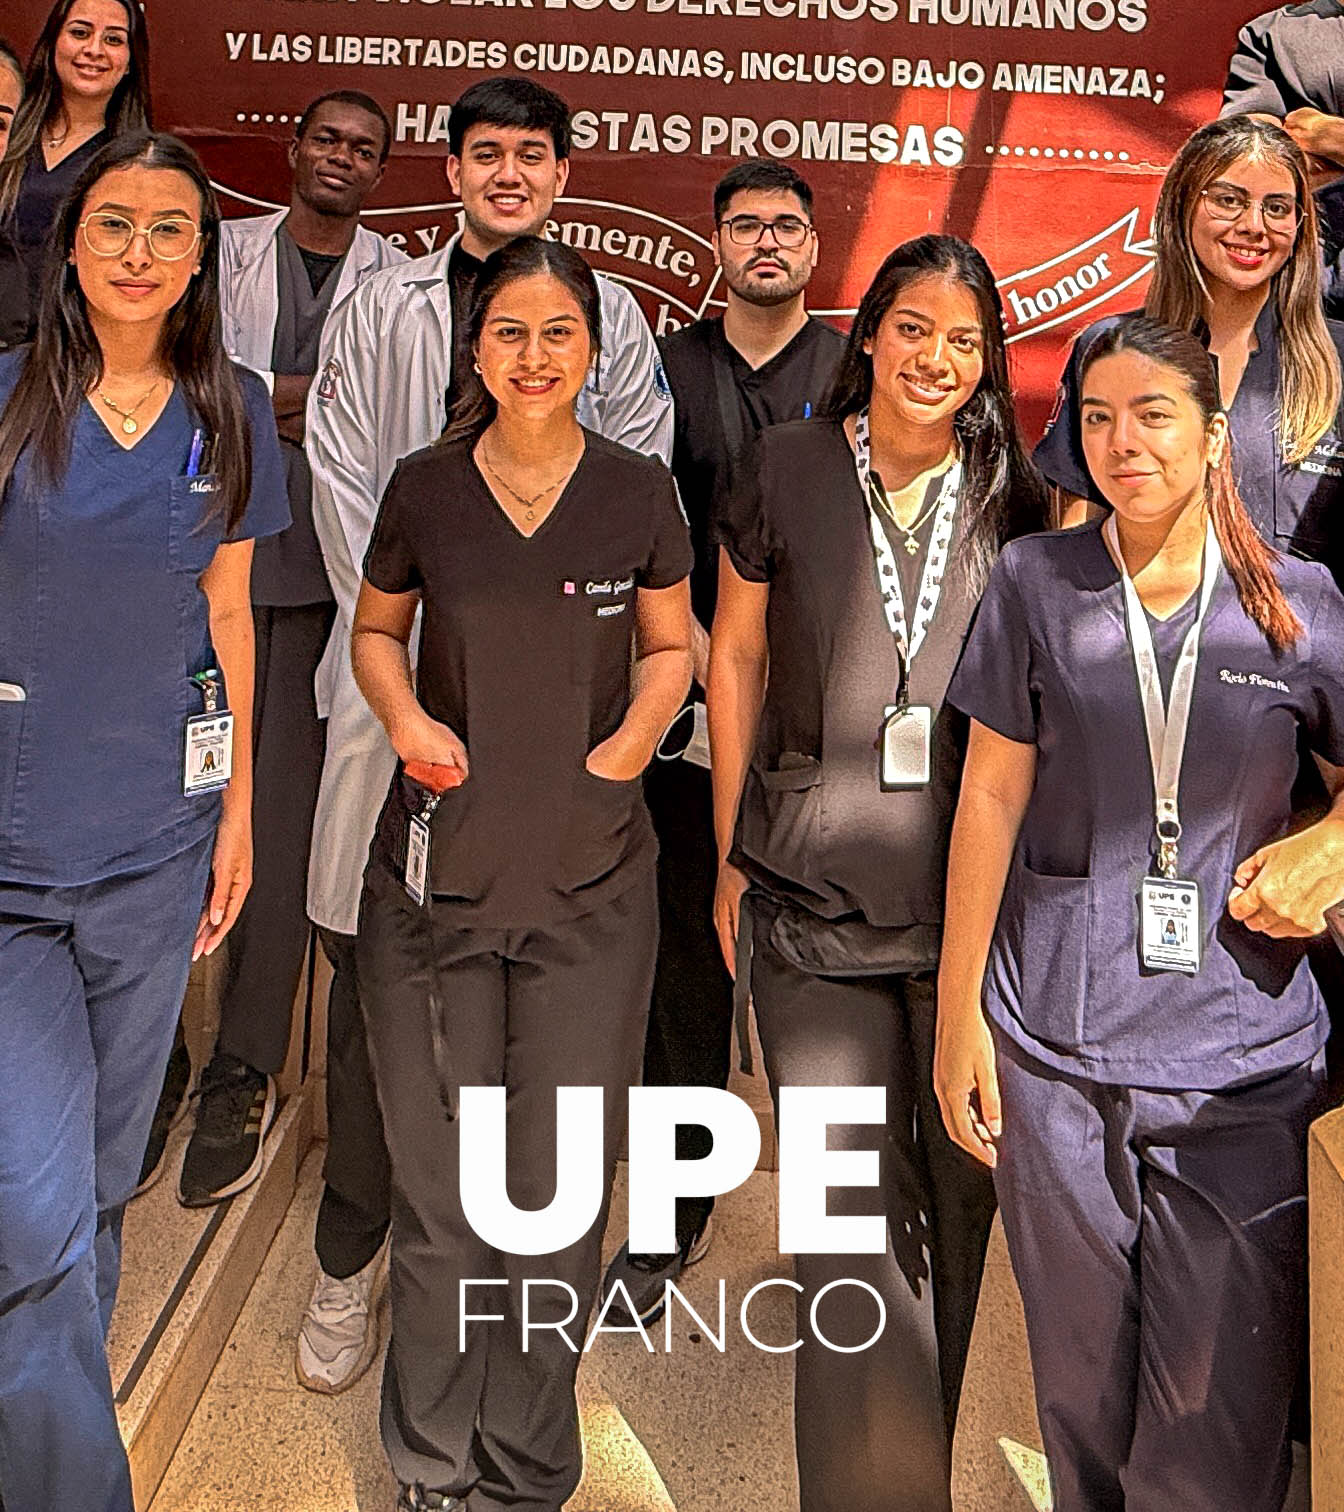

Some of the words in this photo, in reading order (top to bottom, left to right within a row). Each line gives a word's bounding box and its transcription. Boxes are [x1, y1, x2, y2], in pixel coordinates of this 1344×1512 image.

[225, 32, 247, 60] Y
[252, 33, 313, 62] LAS
[317, 35, 507, 69] LIBERTADES
[513, 43, 735, 84] CIUDADANAS,
[740, 51, 885, 85] INCLUSO
[891, 58, 985, 90] BAJO
[992, 62, 1166, 105] AMENAZA;
[395, 103, 452, 143] HA
[570, 110, 692, 153] STAS
[701, 116, 965, 168] PROMESAS
[545, 219, 703, 288] emente,
[1007, 252, 1113, 326] honor
